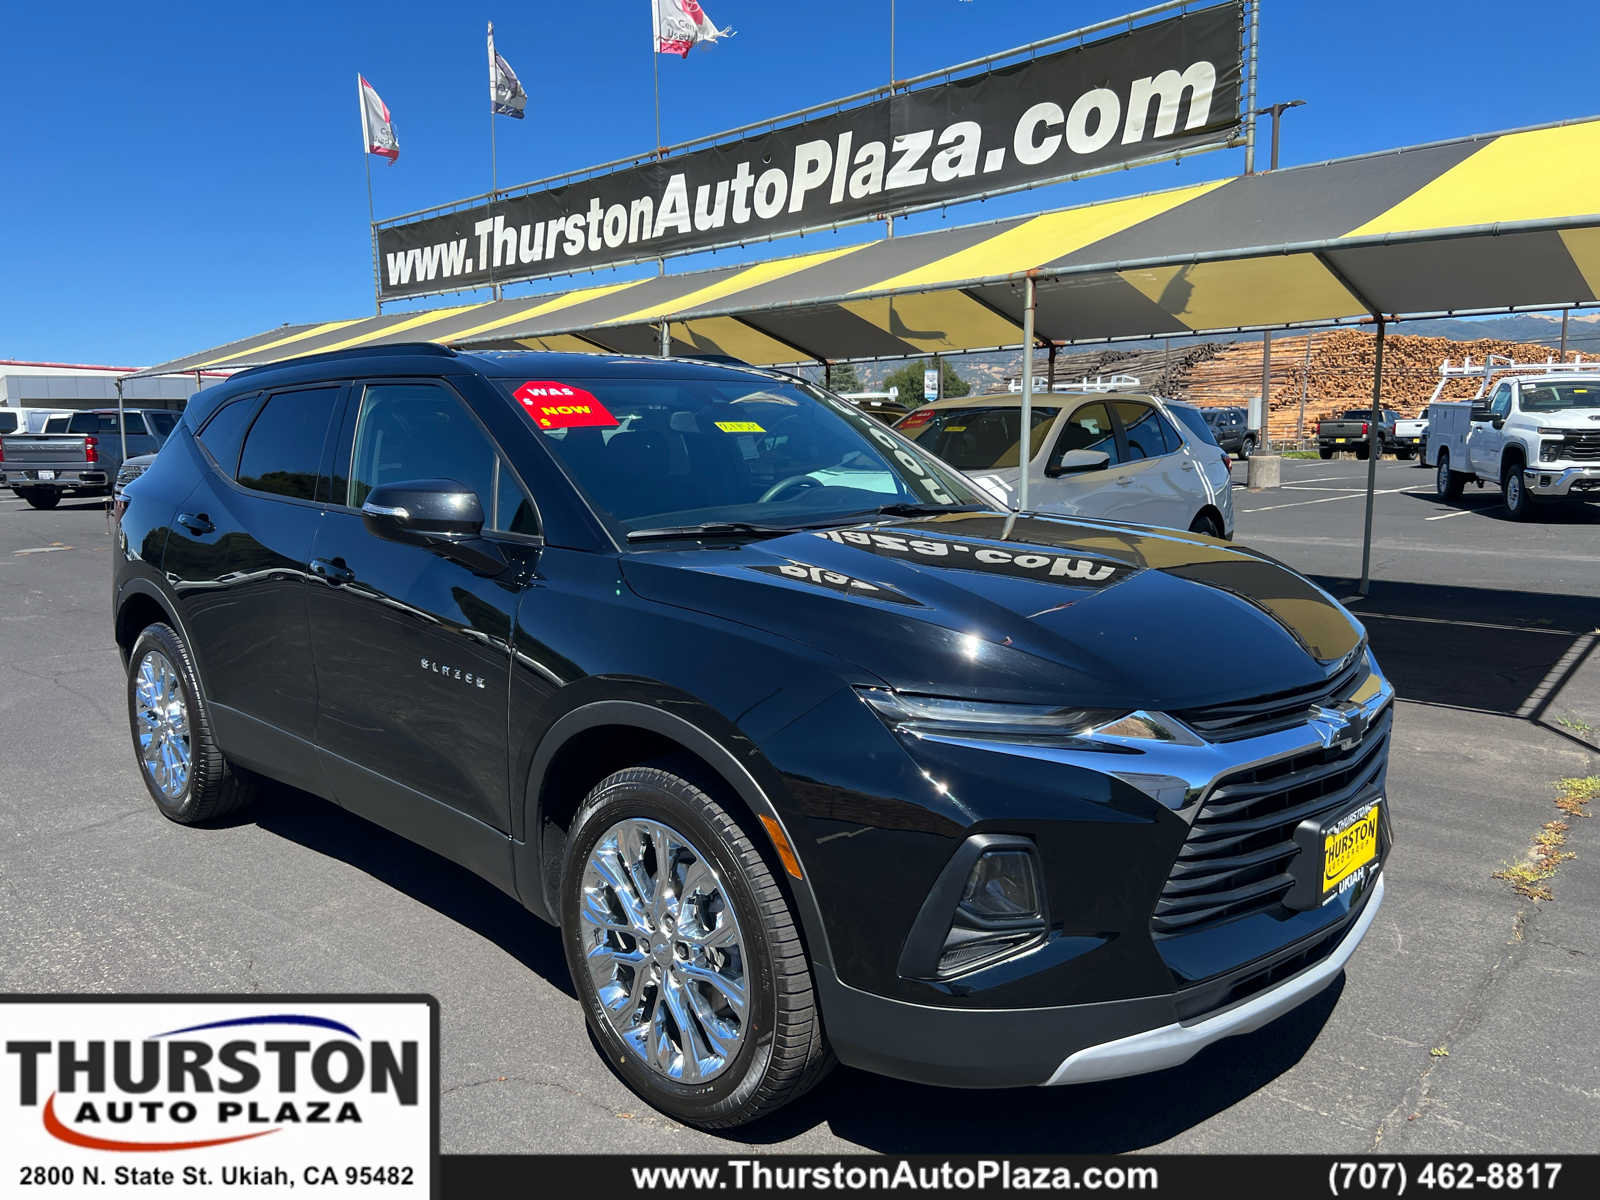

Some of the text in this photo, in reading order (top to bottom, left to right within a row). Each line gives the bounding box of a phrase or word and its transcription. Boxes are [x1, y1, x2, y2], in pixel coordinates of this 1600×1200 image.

[386, 60, 1216, 286] www.ThurstonAutoPlaza.com
[526, 388, 574, 396] WAS
[541, 406, 592, 416] NOW
[1338, 866, 1365, 894] UKIAH
